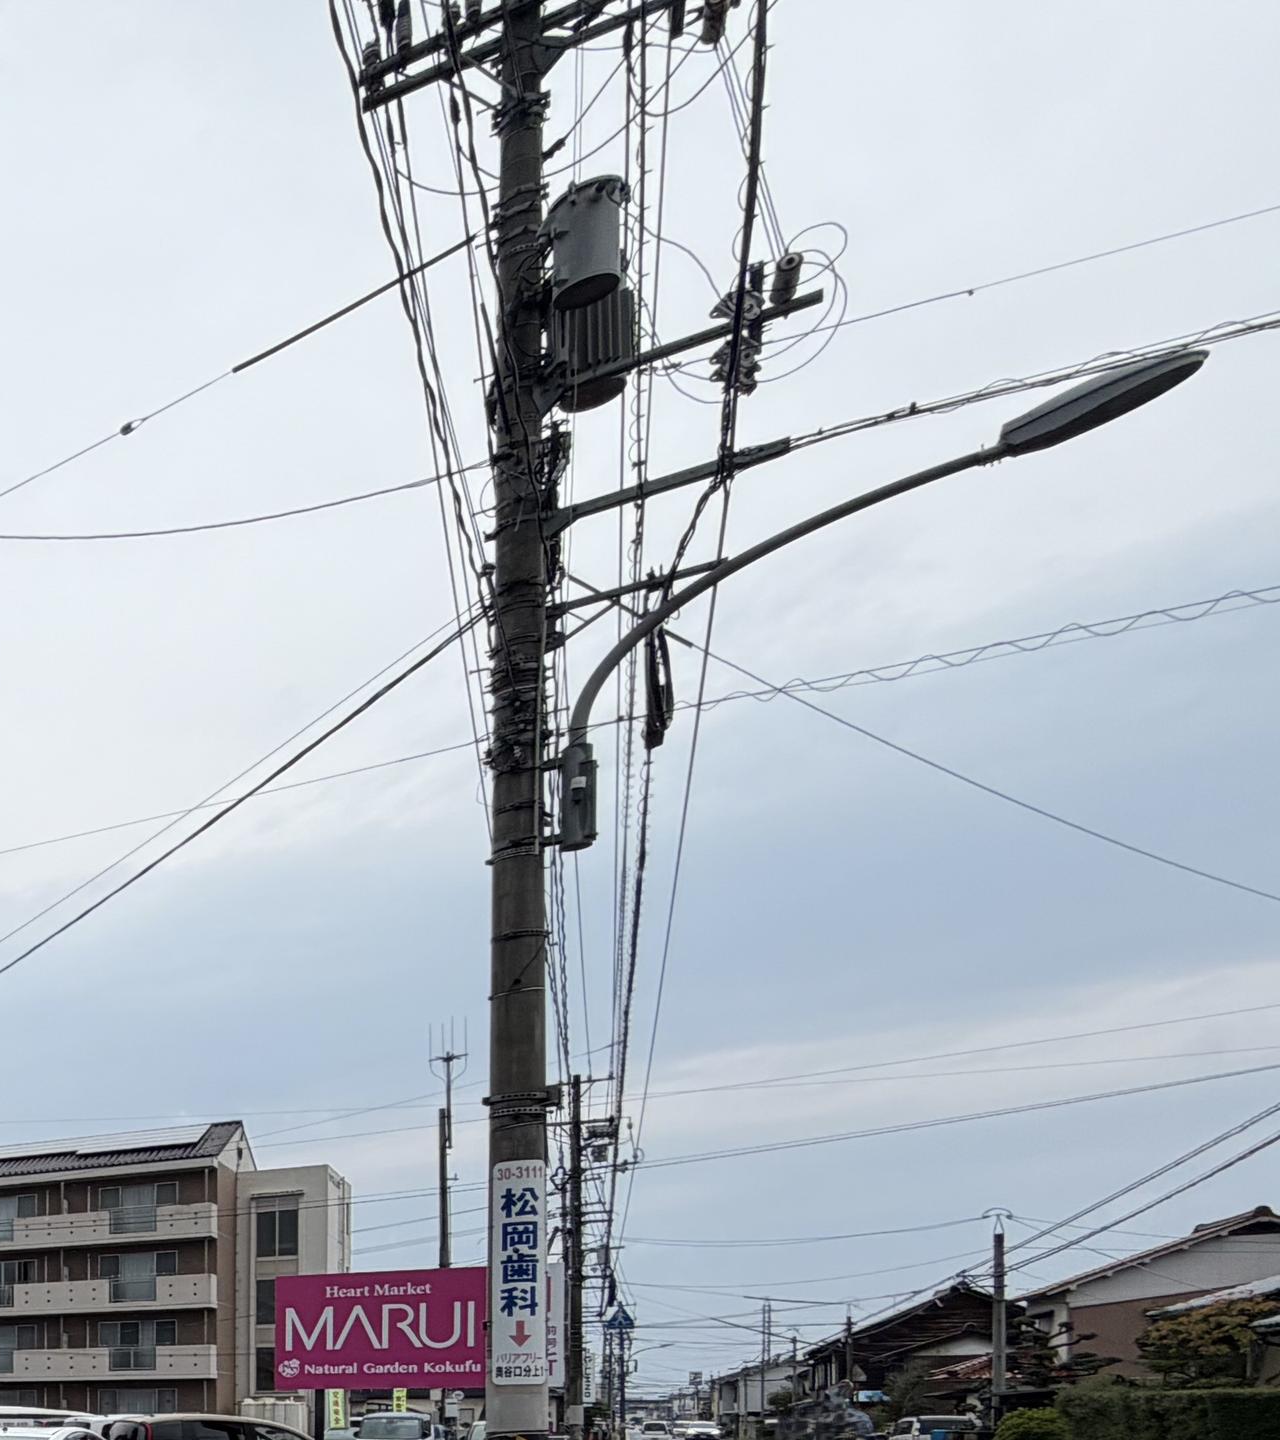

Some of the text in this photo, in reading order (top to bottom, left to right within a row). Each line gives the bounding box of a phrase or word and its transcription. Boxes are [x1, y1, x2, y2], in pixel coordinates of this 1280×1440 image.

[497, 1166, 543, 1181] 30-3111
[500, 1187, 539, 1317] 松岡歯科
[325, 1282, 432, 1298] Heart Market
[285, 1301, 475, 1351] MARUI
[496, 1352, 543, 1364] バリアフリー
[304, 1360, 482, 1375] Natural Garden Kokufu
